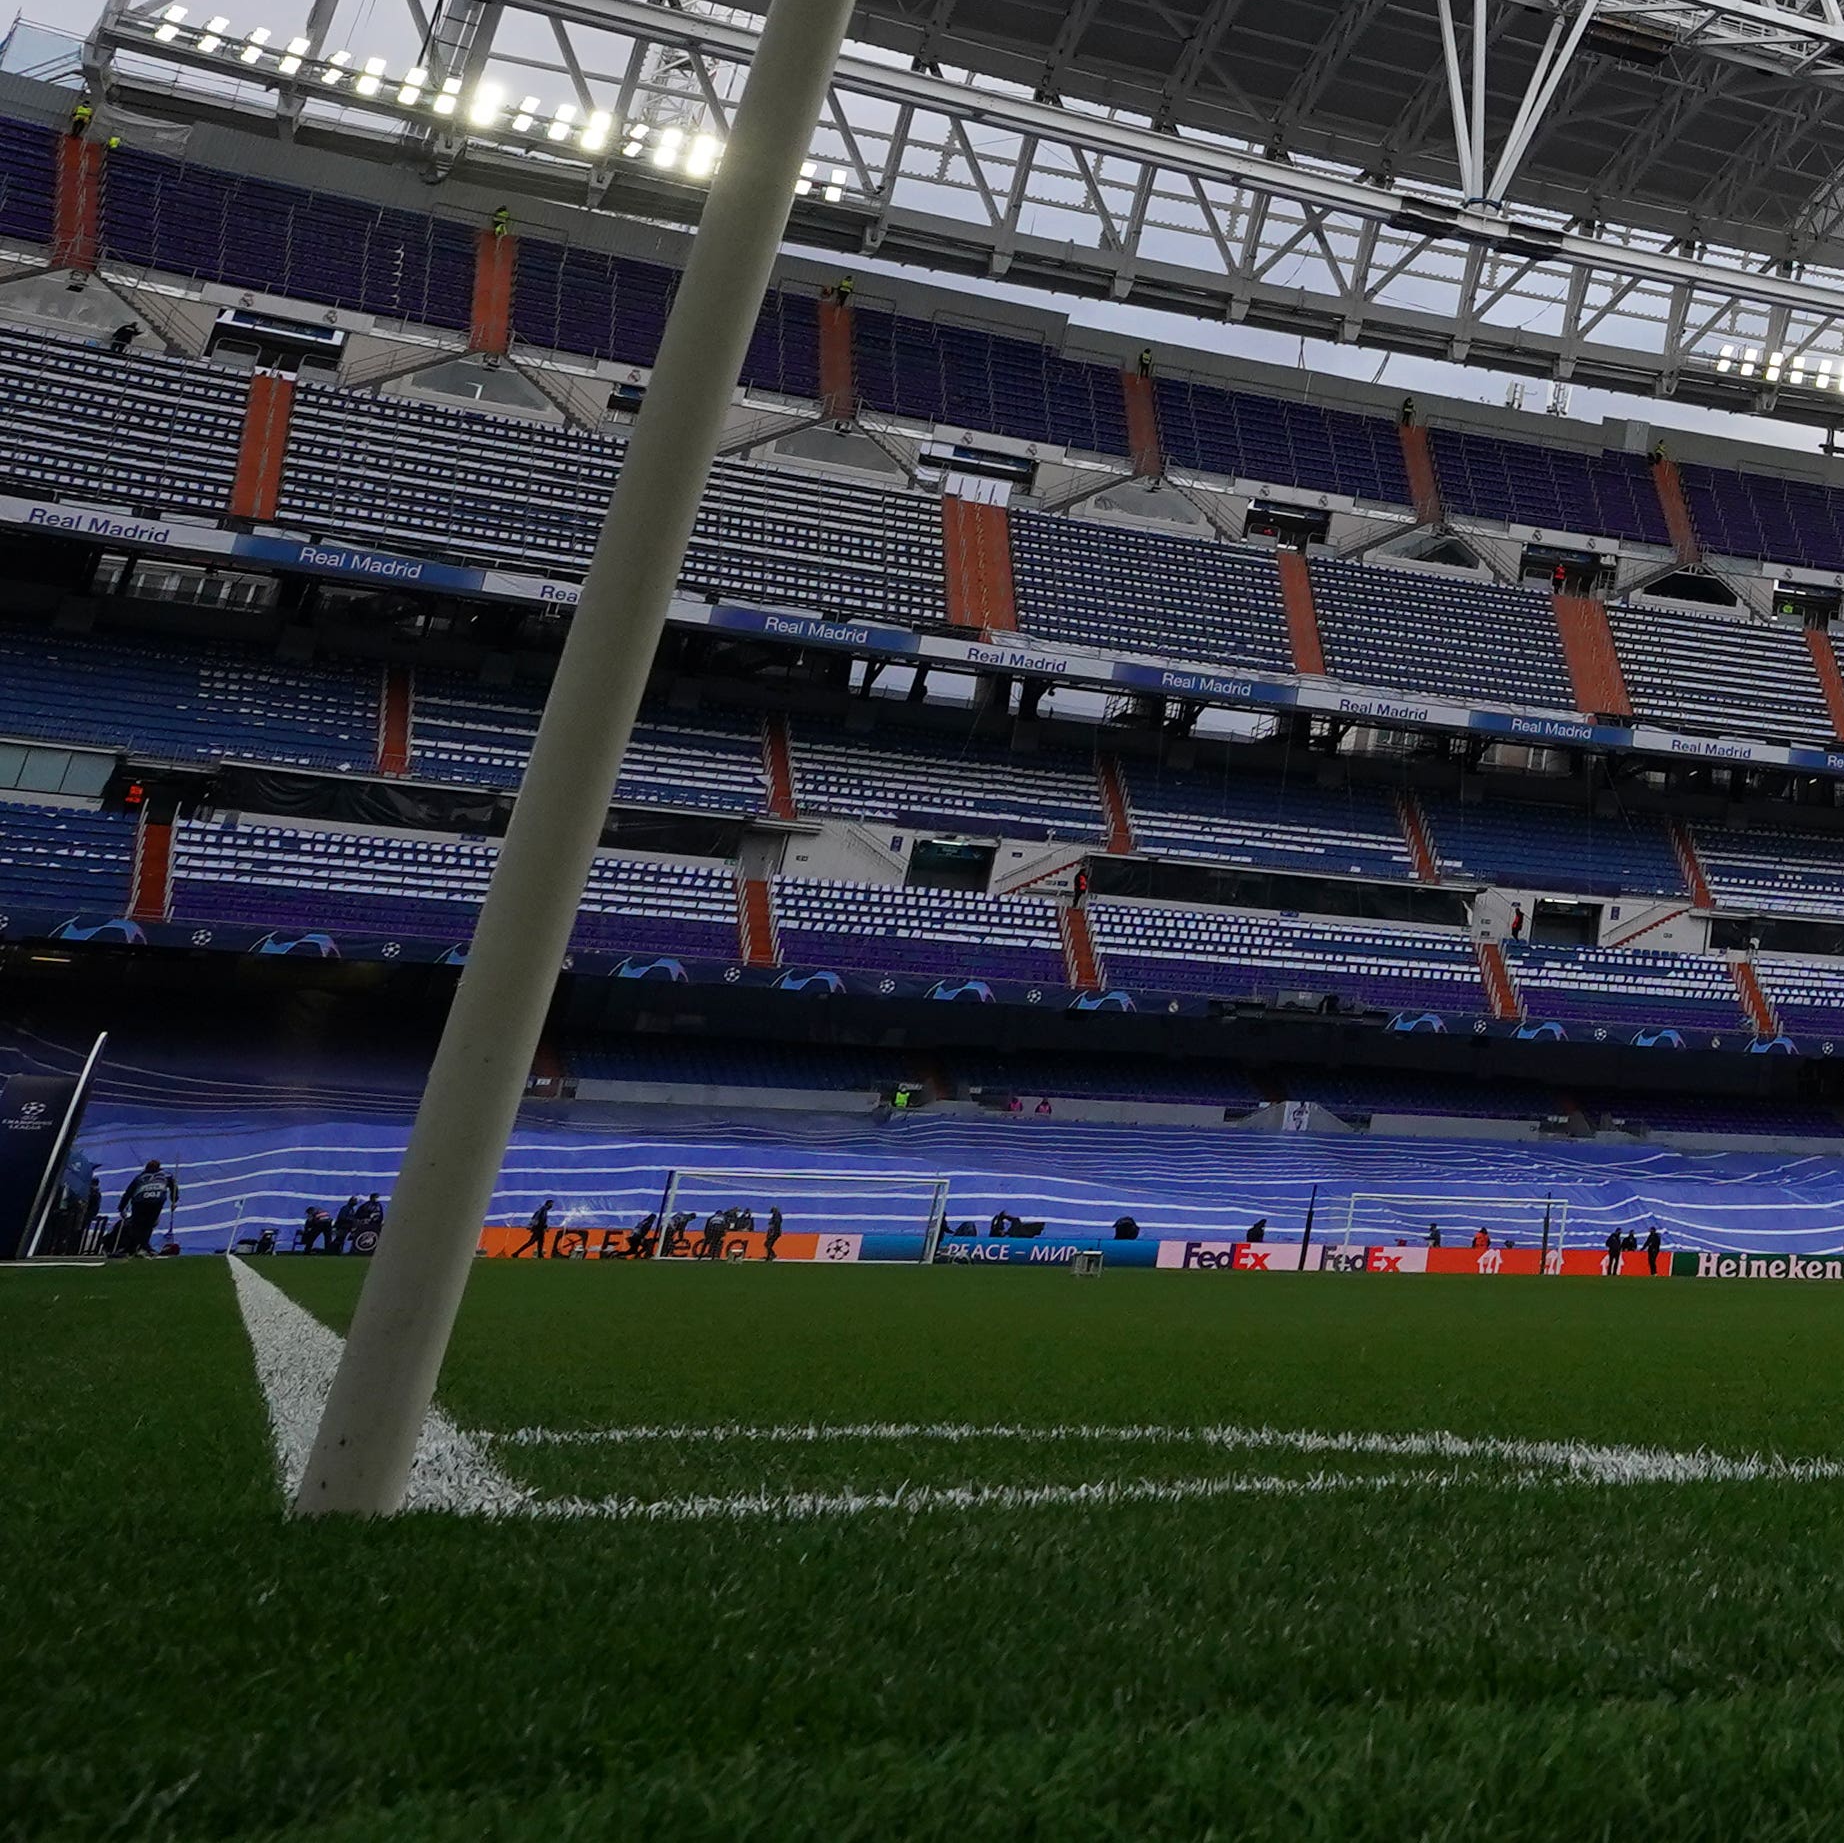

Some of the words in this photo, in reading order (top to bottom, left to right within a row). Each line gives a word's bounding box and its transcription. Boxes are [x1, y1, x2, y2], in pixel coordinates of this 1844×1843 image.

[30, 508, 81, 531] Real
[90, 517, 169, 543] Madrid
[300, 547, 345, 567] Real
[351, 555, 420, 578] Madrid
[541, 585, 578, 602] Rea
[765, 616, 804, 633] Real
[809, 621, 868, 644] Madrid
[967, 648, 1004, 664] Real
[1011, 653, 1066, 672] Madrid
[1162, 672, 1196, 688] Real
[1200, 677, 1251, 696] Madrid
[1340, 699, 1372, 714] Real
[1377, 703, 1427, 721] Madrid
[1512, 718, 1541, 732] Real
[1546, 722, 1591, 739] Madrid
[1672, 739, 1701, 753] Real
[1706, 743, 1751, 758] Madrid
[1030, 1245, 1077, 1262] МИР
[1184, 1243, 1270, 1270] FedEx
[1320, 1245, 1402, 1273] FedEx
[1697, 1253, 1843, 1279] Heineken
